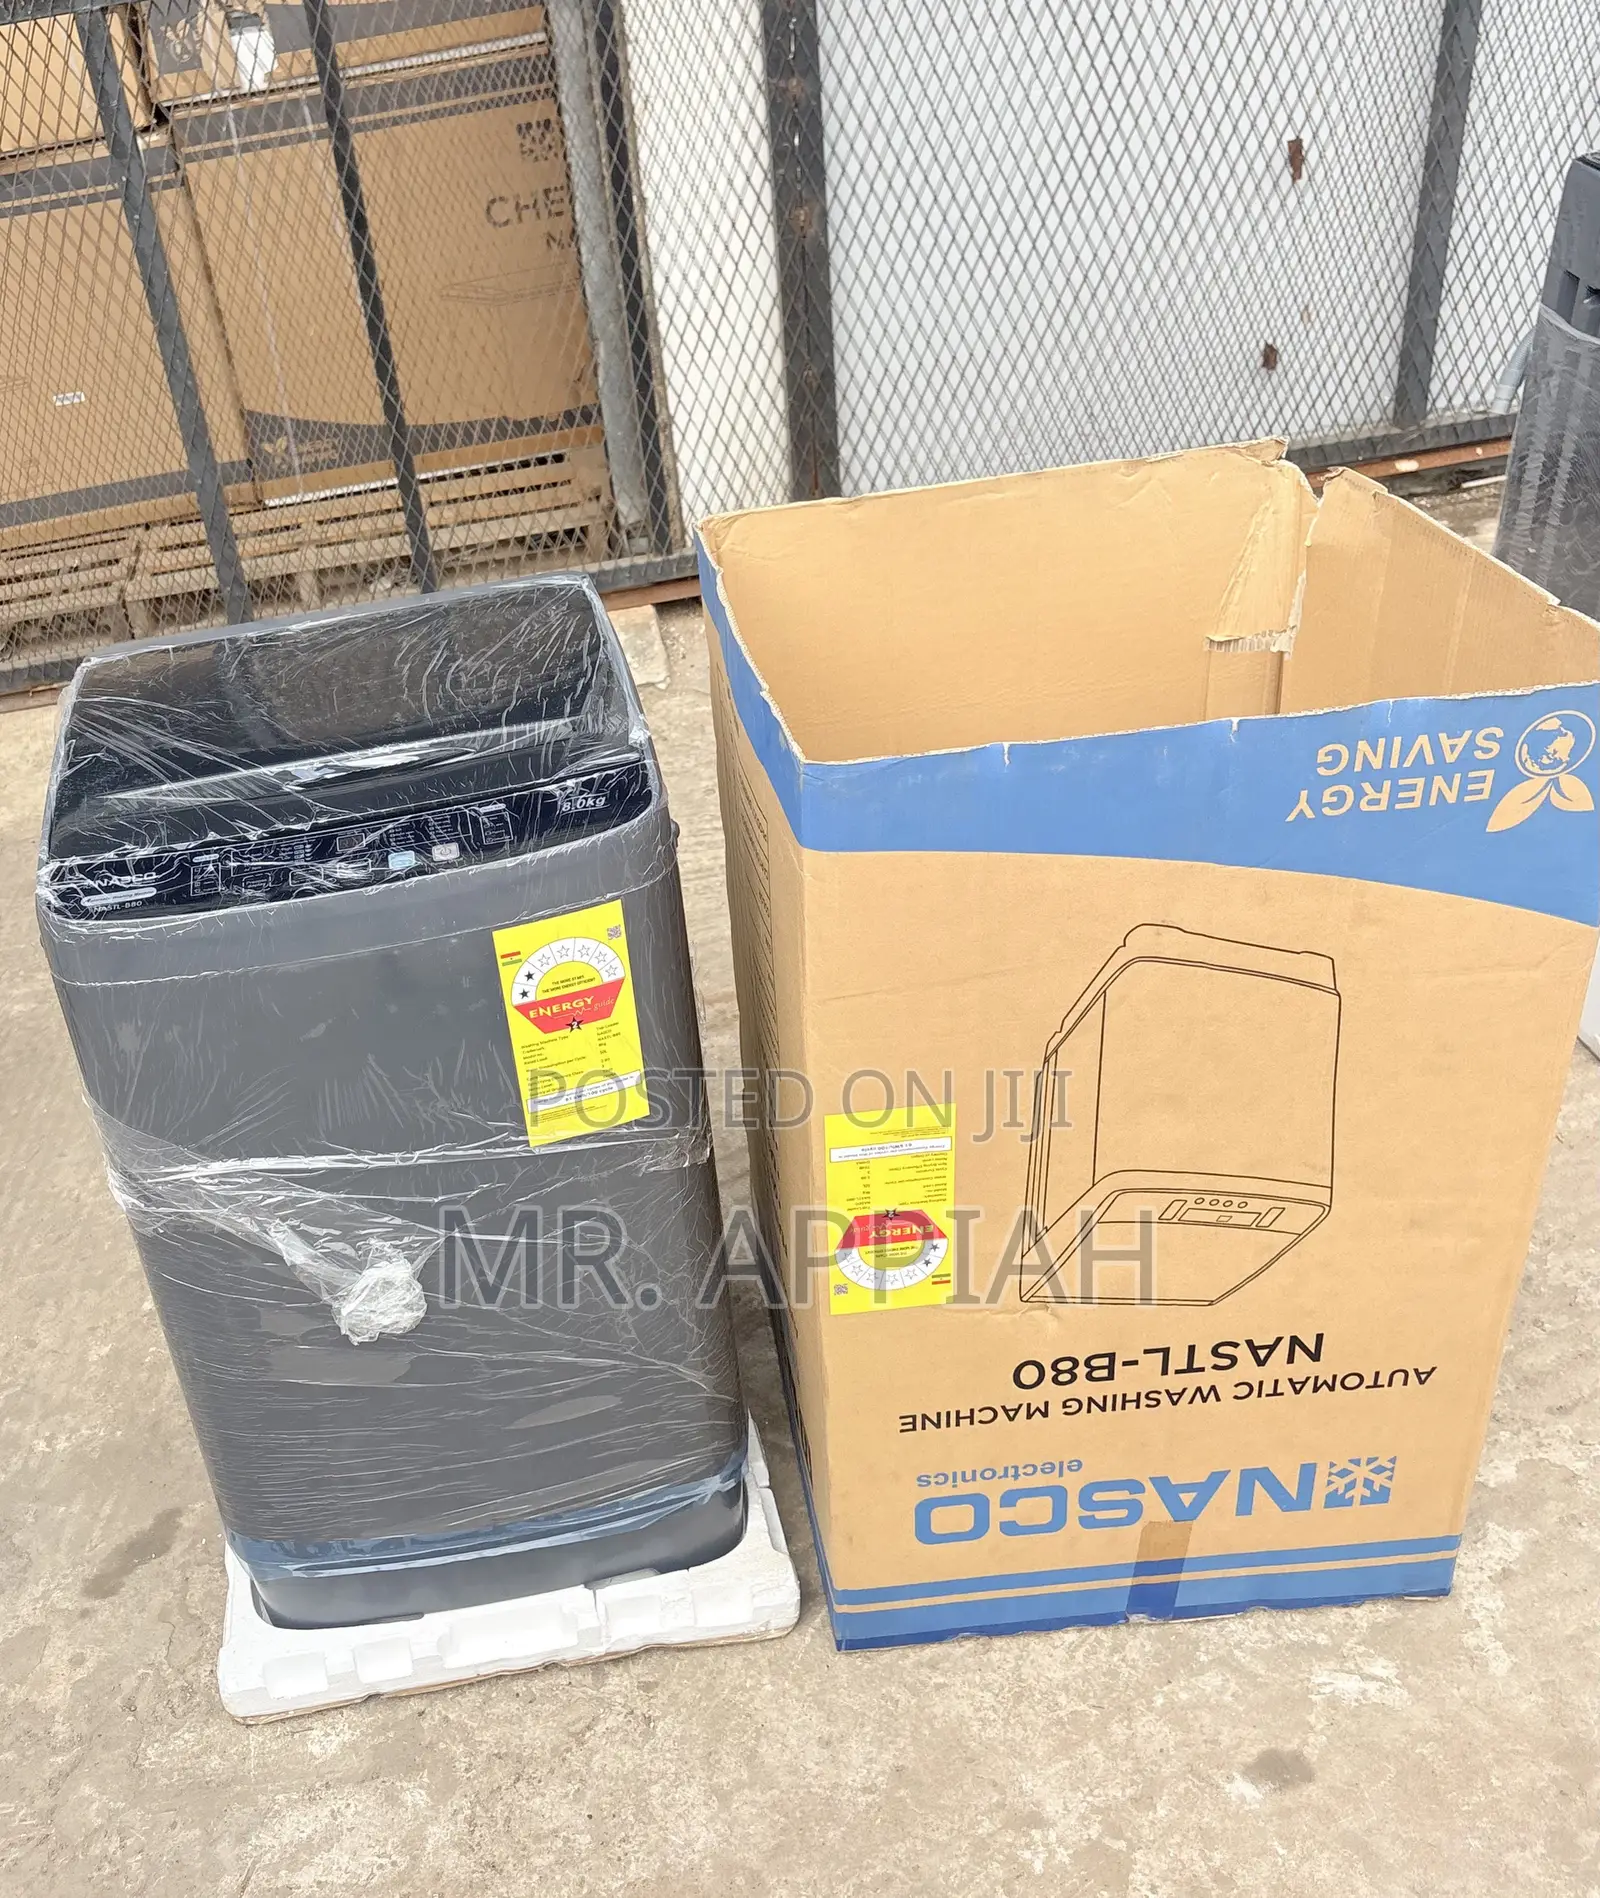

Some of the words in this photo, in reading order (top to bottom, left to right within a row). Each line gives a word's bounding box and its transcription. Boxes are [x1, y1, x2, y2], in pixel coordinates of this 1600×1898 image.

[1316, 727, 1504, 776] SAVING
[562, 796, 606, 812] 8.0kg
[1285, 769, 1495, 822] ENERGY
[529, 996, 594, 1019] ENERGY
[594, 997, 615, 1012] guide
[870, 1224, 934, 1239] ENERGY
[1012, 1333, 1324, 1390] NASTL-B80
[1232, 1366, 1437, 1400] AUTOMATIC
[1062, 1384, 1221, 1416] WASHING
[899, 1400, 1049, 1433] MACHINE
[916, 1459, 1083, 1488] electronics
[914, 1462, 1317, 1545] NASCO
